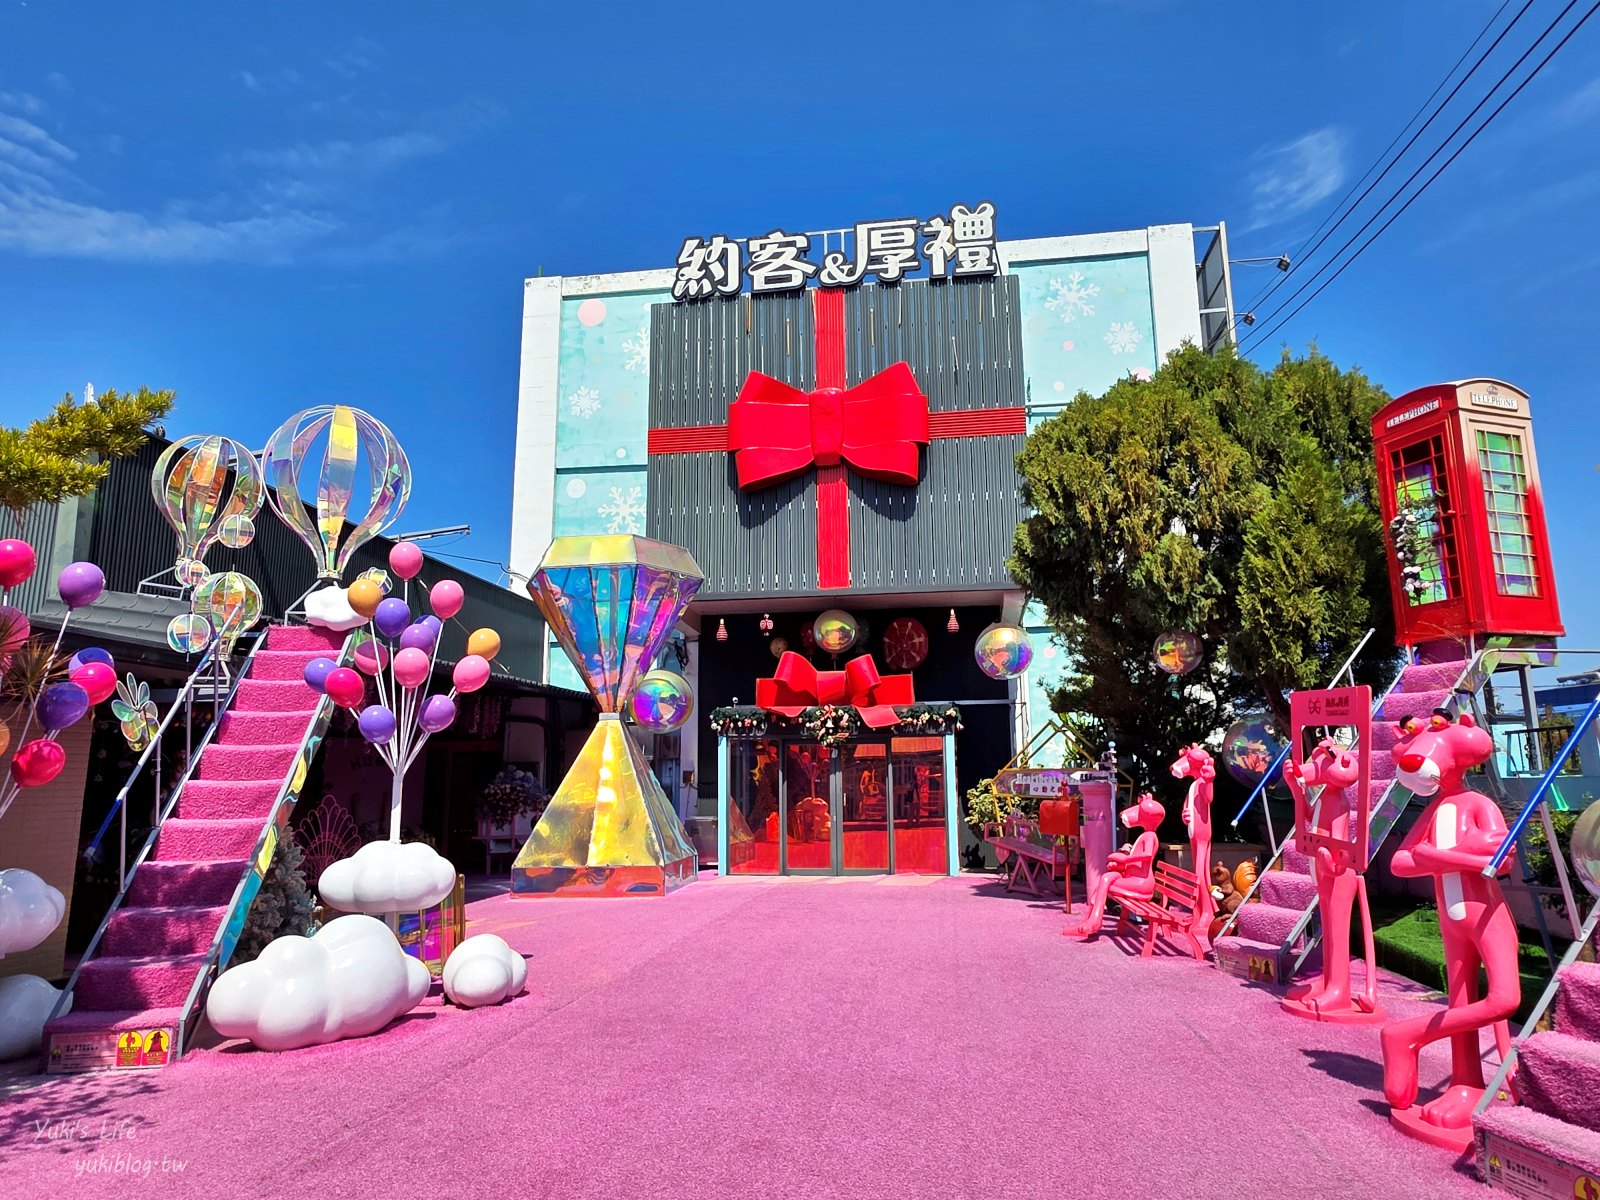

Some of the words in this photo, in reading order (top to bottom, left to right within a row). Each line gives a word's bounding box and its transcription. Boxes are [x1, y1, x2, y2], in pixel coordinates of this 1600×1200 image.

[672, 201, 998, 300] 約客&厚禮
[1388, 401, 1437, 427] TELEPHONE
[1473, 394, 1516, 408] TELEPHONE
